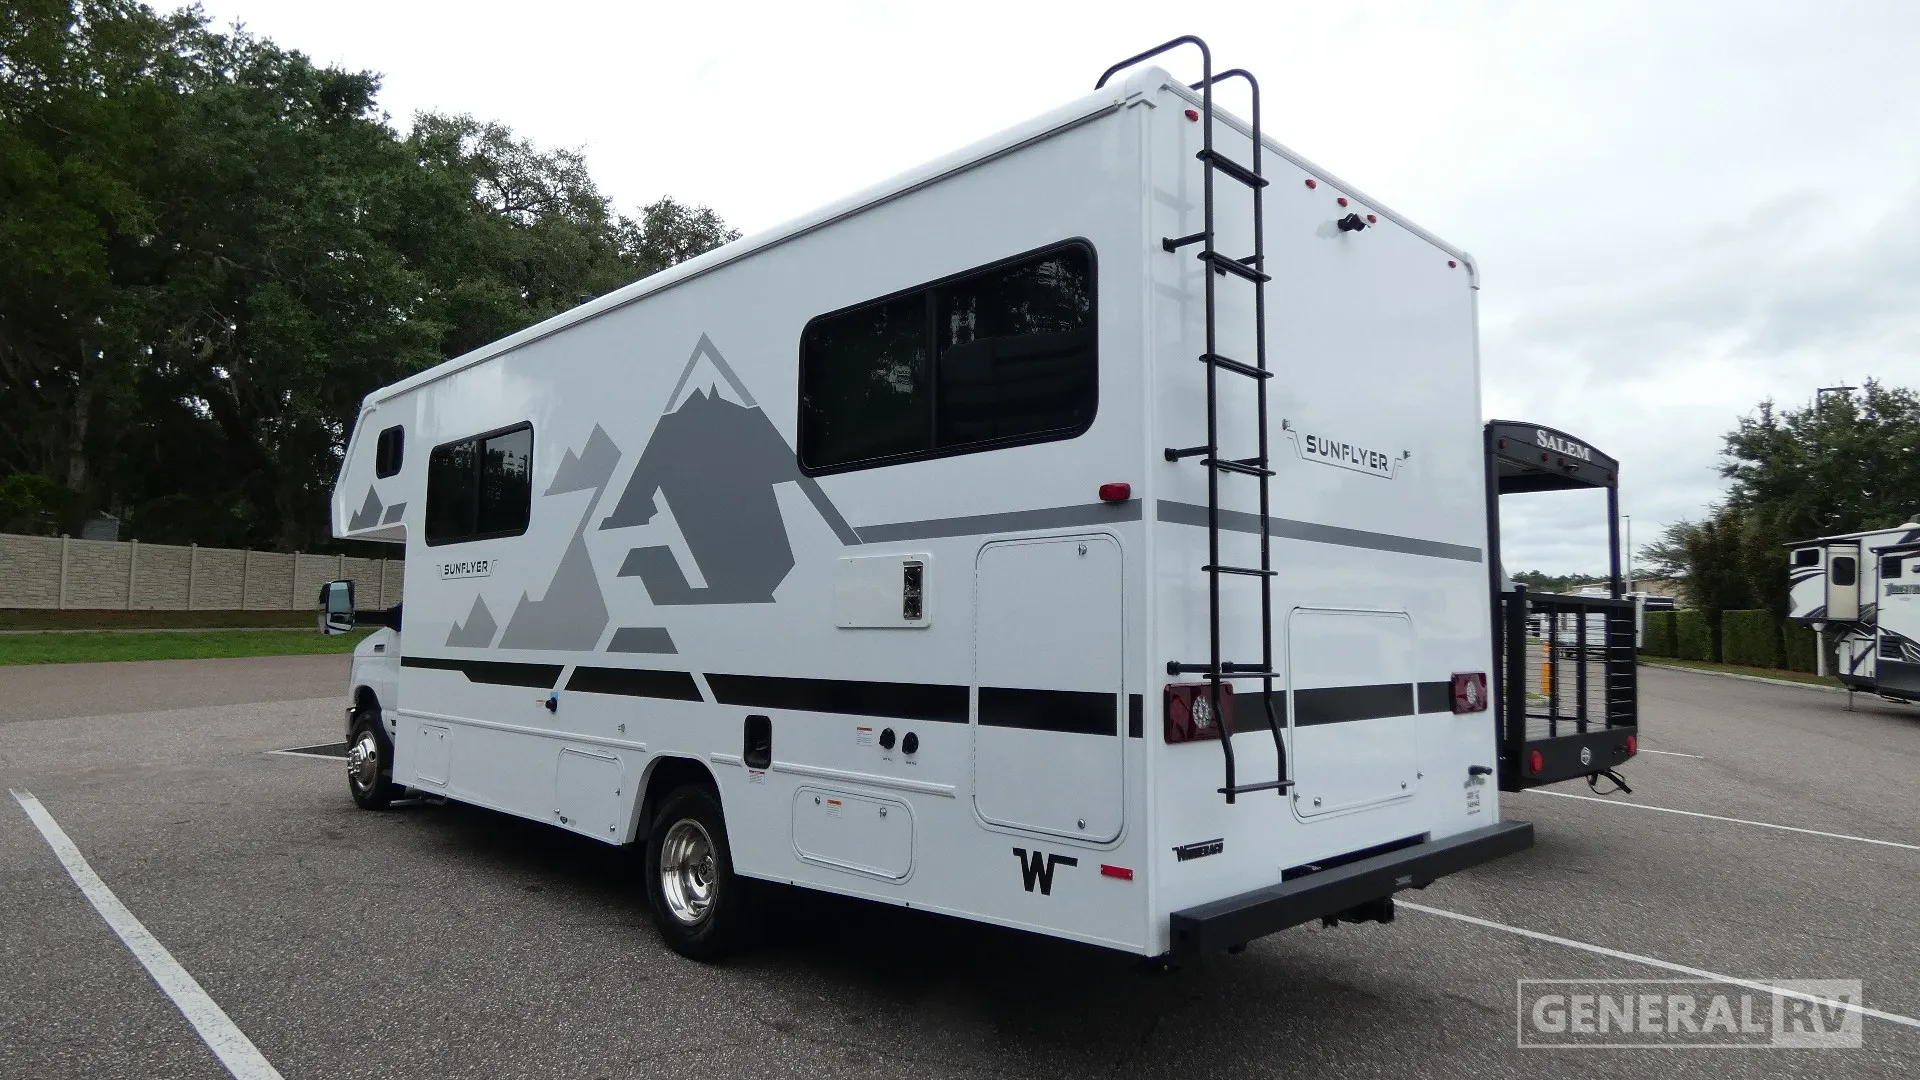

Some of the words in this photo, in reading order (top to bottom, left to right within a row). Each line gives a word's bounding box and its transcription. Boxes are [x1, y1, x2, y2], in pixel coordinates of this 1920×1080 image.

[1306, 434, 1388, 472] SUNFLYER
[1536, 429, 1591, 461] SALEM
[444, 560, 488, 575] SUNFLYER
